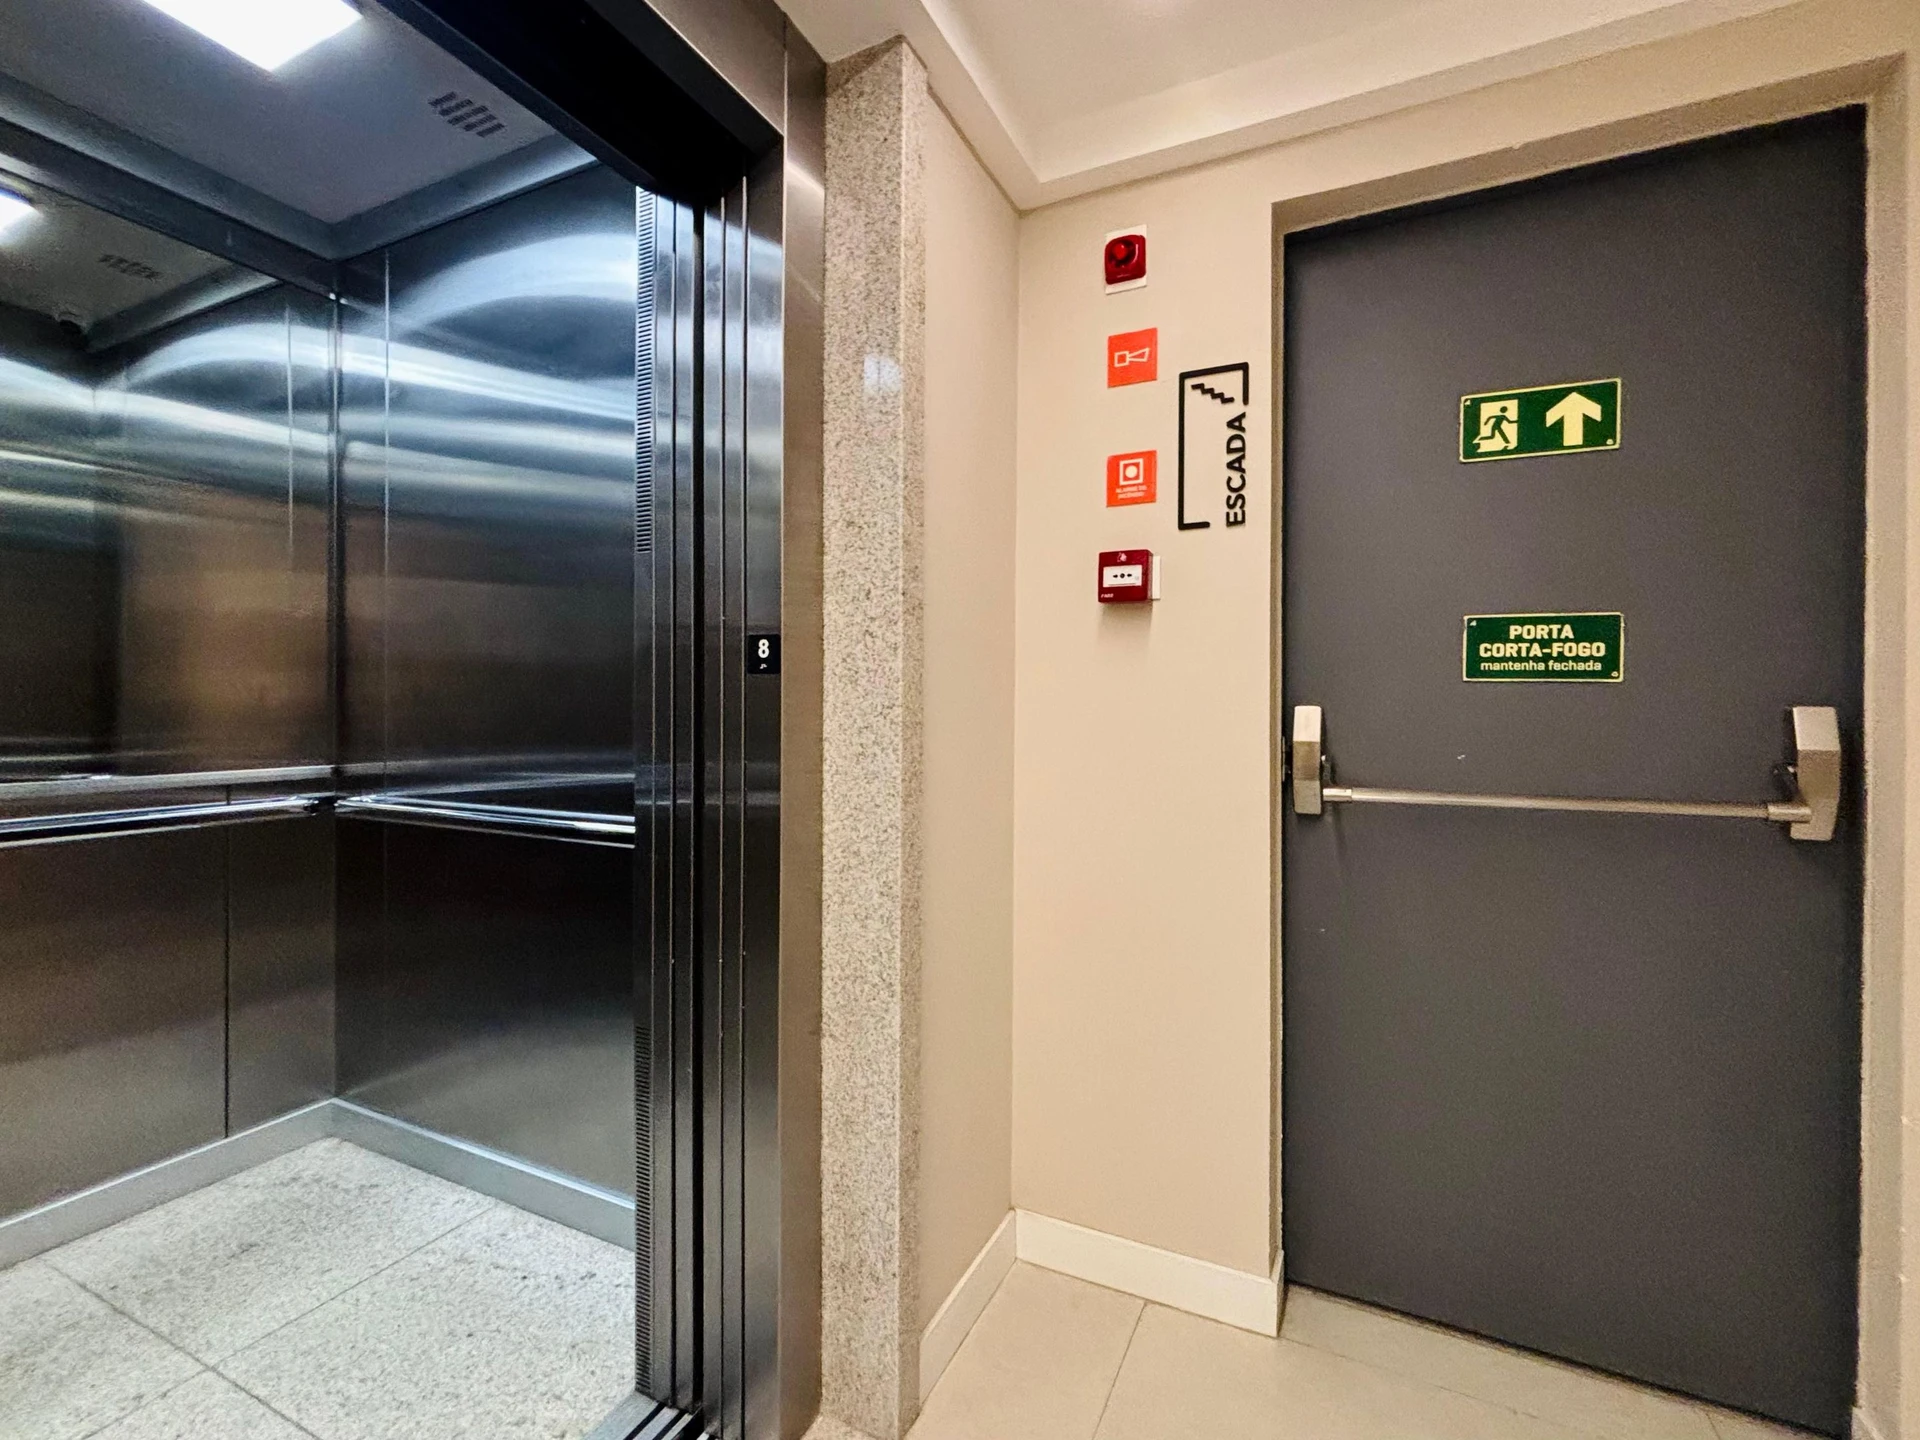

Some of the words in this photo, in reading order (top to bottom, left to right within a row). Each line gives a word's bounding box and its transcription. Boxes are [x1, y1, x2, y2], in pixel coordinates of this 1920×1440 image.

[1226, 411, 1246, 528] ESCADA
[1509, 624, 1574, 640] PORTA
[758, 638, 770, 658] 8
[1479, 642, 1606, 658] CORTA-FOGO
[1480, 660, 1545, 671] mantenha
[1548, 660, 1602, 671] fechada
